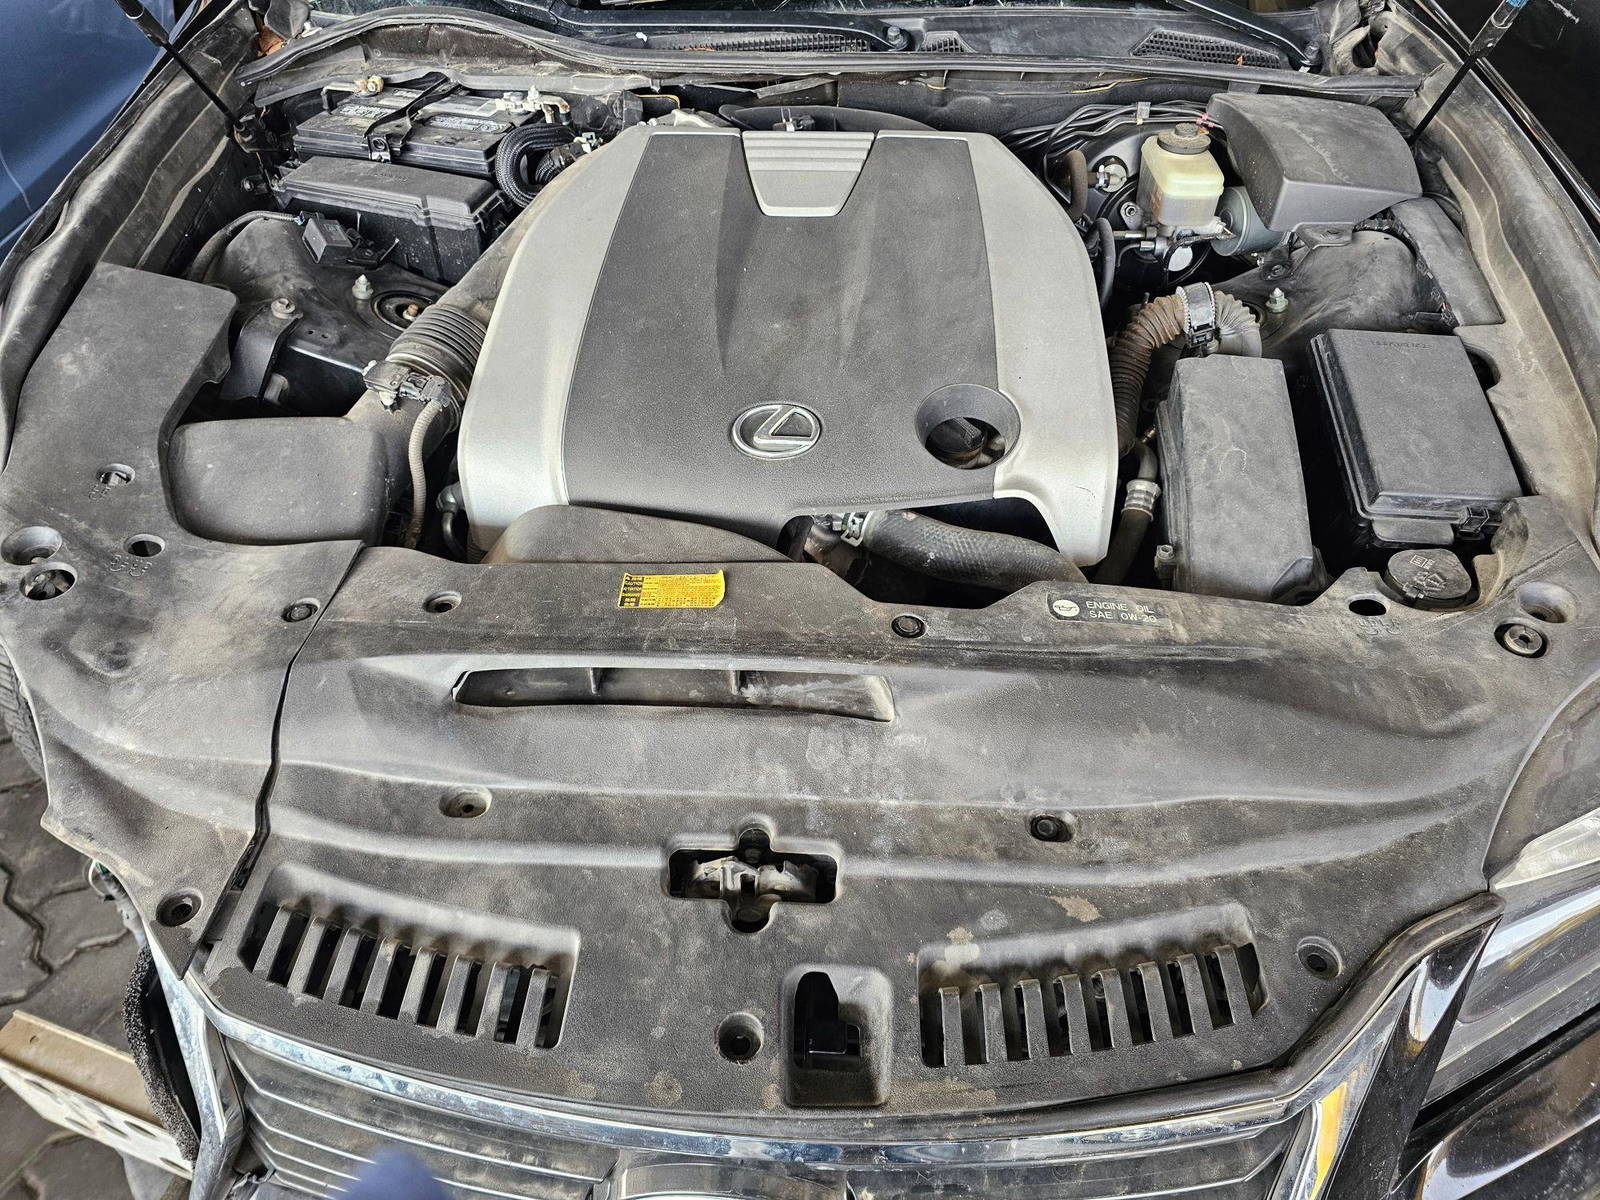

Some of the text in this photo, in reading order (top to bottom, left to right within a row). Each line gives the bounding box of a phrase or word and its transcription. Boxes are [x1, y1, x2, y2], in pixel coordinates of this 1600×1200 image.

[1086, 601, 1155, 614] ENGINE OIL
[1089, 611, 1157, 623] SAE 0W-20
